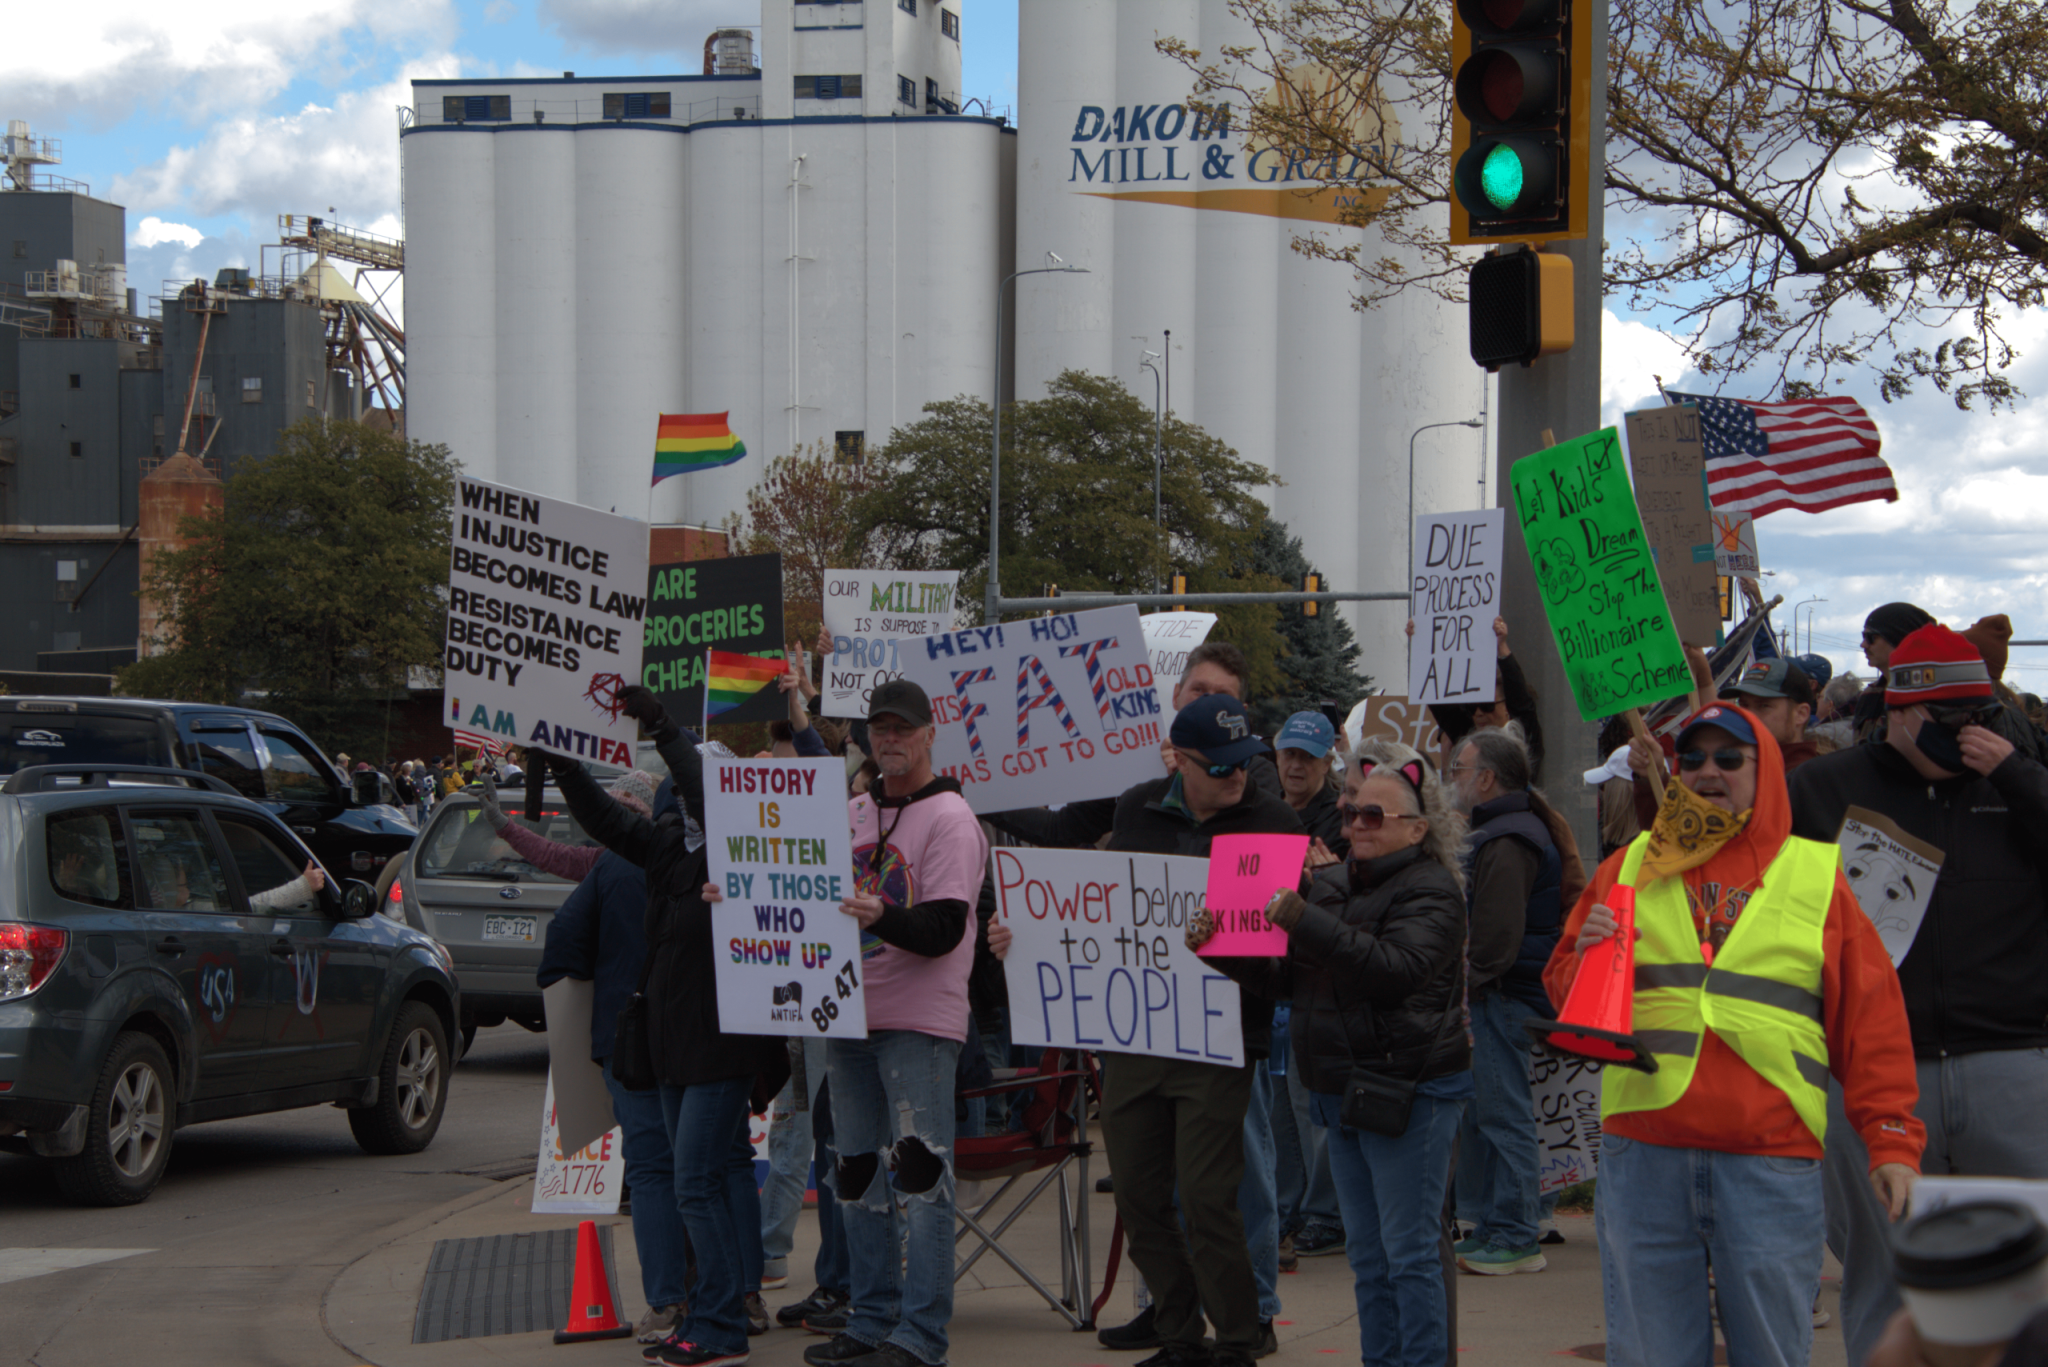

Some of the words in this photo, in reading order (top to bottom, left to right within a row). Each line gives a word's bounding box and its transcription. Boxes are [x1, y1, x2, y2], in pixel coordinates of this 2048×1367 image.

[1071, 103, 1230, 143] DAKOTA
[1067, 146, 1190, 183] MILL
[1201, 144, 1234, 180] &
[1247, 145, 1400, 183] GRAIN
[1674, 412, 1697, 439] NOT
[460, 481, 540, 525] WHEN
[1514, 478, 1546, 529] Let
[1549, 465, 1604, 519] Kids
[460, 514, 609, 578] INJUSTICE
[1425, 523, 1487, 571] DUE
[1578, 518, 1640, 559] Dream
[452, 546, 582, 605] BECOMES
[589, 584, 646, 622] LAW
[652, 567, 697, 602] ARE
[828, 580, 859, 598] OUR
[869, 581, 956, 614] MILITARY
[1412, 572, 1495, 616] PROCESS
[1588, 580, 1625, 620] Stop
[1623, 567, 1656, 597] The
[450, 586, 621, 655] RESISTANCE
[643, 603, 765, 648] GROCERIES
[854, 617, 872, 632] IS
[880, 618, 928, 635] SUPPOSE
[926, 625, 1004, 661] HEY!
[1030, 614, 1080, 642] HO!
[1154, 619, 1204, 638] TIDE
[1431, 615, 1475, 654] FOR
[1557, 614, 1664, 663] Billionaire
[448, 616, 580, 672] BECOMES
[446, 645, 523, 687] DUTY
[830, 671, 866, 690] NOT
[1419, 656, 1481, 700] ALL
[1610, 652, 1692, 699] Scheme
[930, 694, 963, 724] HIS
[950, 636, 1120, 758] FAT
[1105, 663, 1155, 693] OLD
[1111, 688, 1161, 719] KING
[452, 697, 460, 721] I
[468, 704, 517, 737] AM
[529, 719, 634, 769] ANTIFA
[1002, 746, 1049, 777] GOT
[1059, 737, 1095, 763] TO
[1103, 721, 1161, 755] GO!!!
[719, 766, 817, 796] HISTORY
[758, 801, 781, 828] IS
[1845, 819, 1869, 838] Stop
[1871, 831, 1887, 848] the
[726, 835, 827, 865] WRITTEN
[1237, 854, 1260, 877] NO
[726, 872, 755, 899] BY
[767, 873, 843, 902] THOSE
[995, 850, 1119, 923] Power
[753, 905, 805, 933] WHO
[1216, 909, 1273, 933] KINGS
[729, 937, 791, 967] SHOW
[801, 942, 832, 969] UP
[1059, 928, 1100, 963] to
[1114, 927, 1170, 971] the
[202, 965, 234, 1022] USA
[811, 995, 839, 1033] 86
[834, 959, 859, 1000] 47
[1036, 962, 1233, 1061] PEOPLE
[770, 1008, 804, 1022] ANTIFA
[1541, 1093, 1581, 1151] SPY
[554, 1133, 613, 1162] SCE
[559, 1164, 605, 1195] 1776
